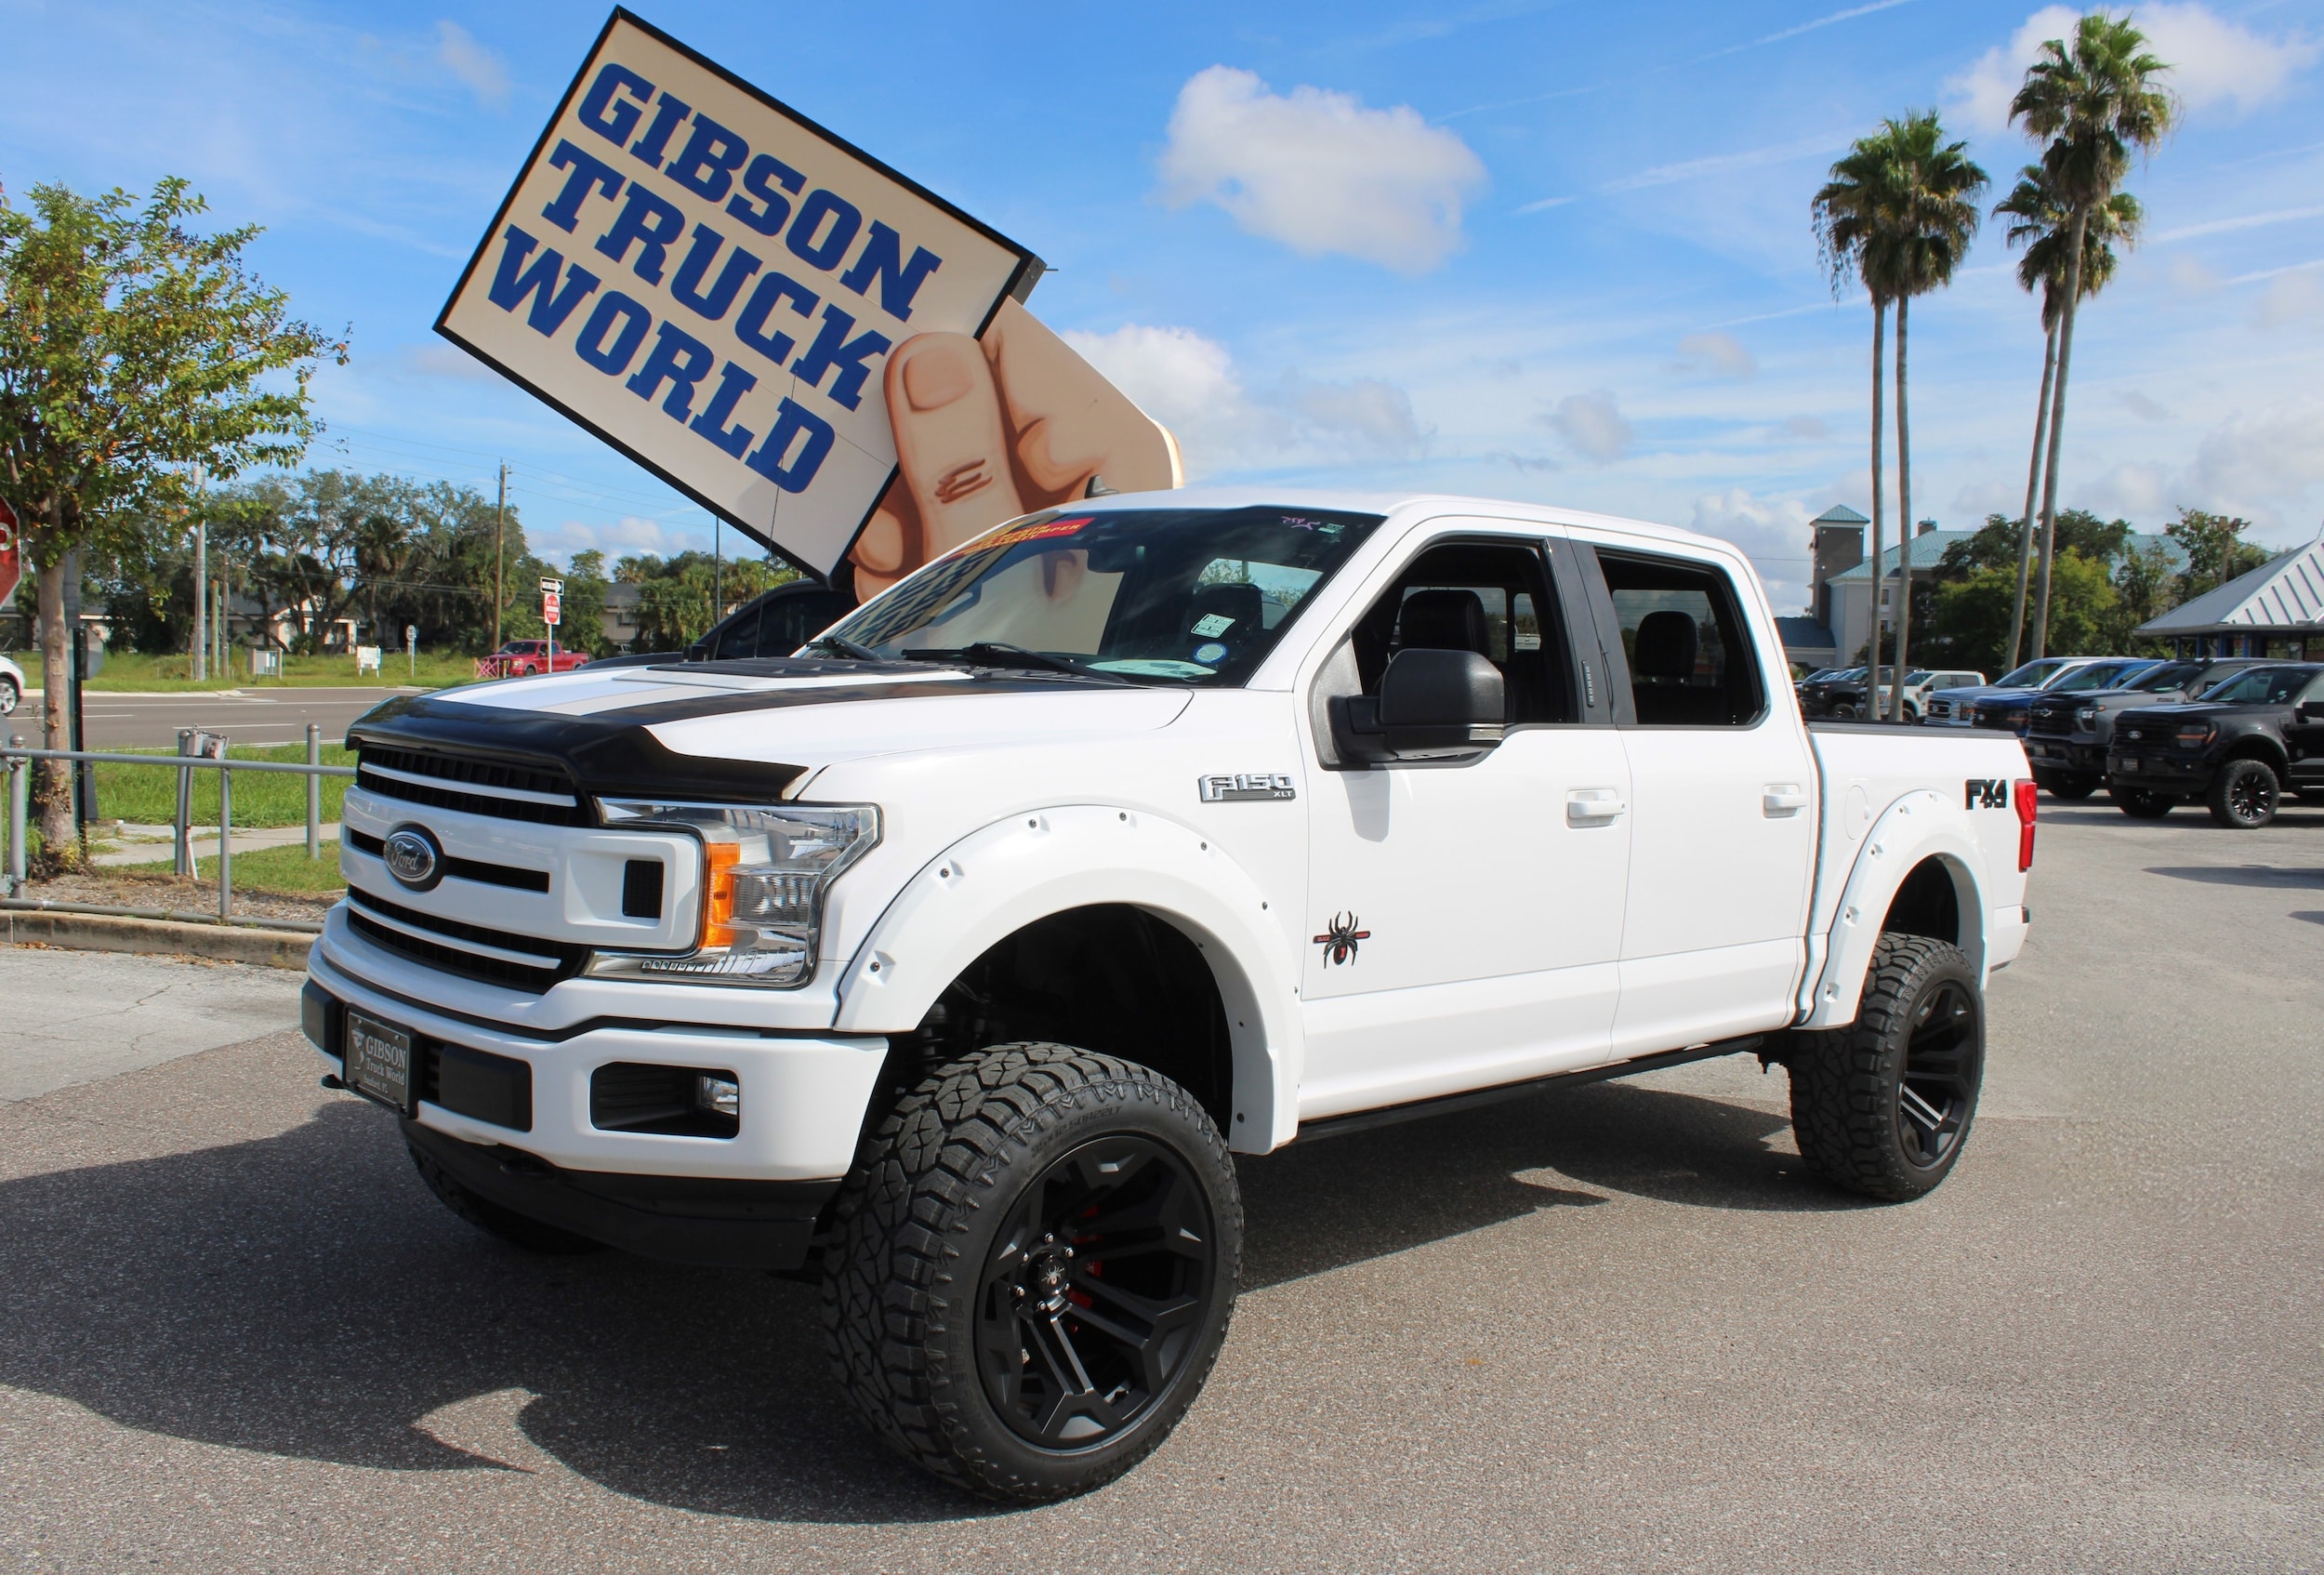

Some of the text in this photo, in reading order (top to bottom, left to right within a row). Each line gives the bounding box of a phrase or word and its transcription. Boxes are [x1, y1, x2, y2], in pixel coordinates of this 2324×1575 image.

[577, 62, 942, 322] GIBSON
[541, 139, 892, 412] TRUCK
[487, 224, 835, 494] WORLD
[1964, 778, 2007, 810] FX4
[391, 841, 419, 870] Ford
[366, 1036, 406, 1069] GIBSON
[366, 1057, 405, 1086] Truck World
